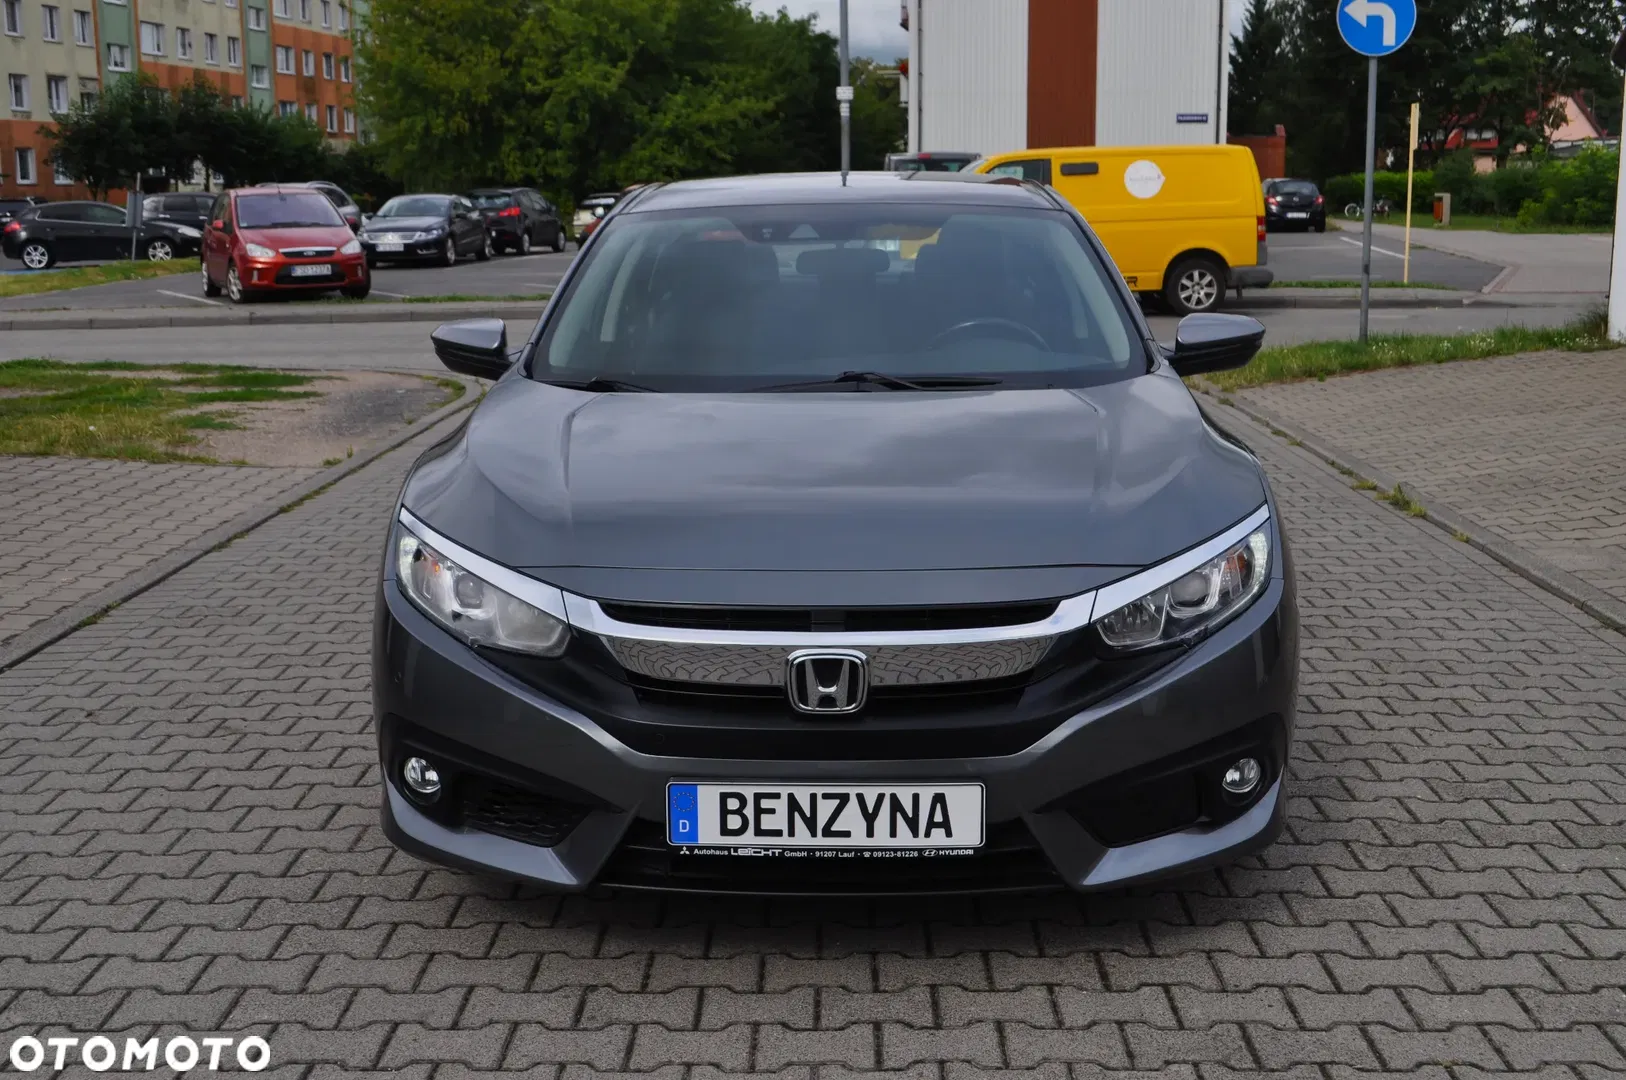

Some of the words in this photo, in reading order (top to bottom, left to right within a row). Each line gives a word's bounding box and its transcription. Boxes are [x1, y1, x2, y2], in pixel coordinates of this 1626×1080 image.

[719, 792, 953, 838] BENZYNA
[679, 820, 689, 833] D
[838, 850, 855, 858] Lauf
